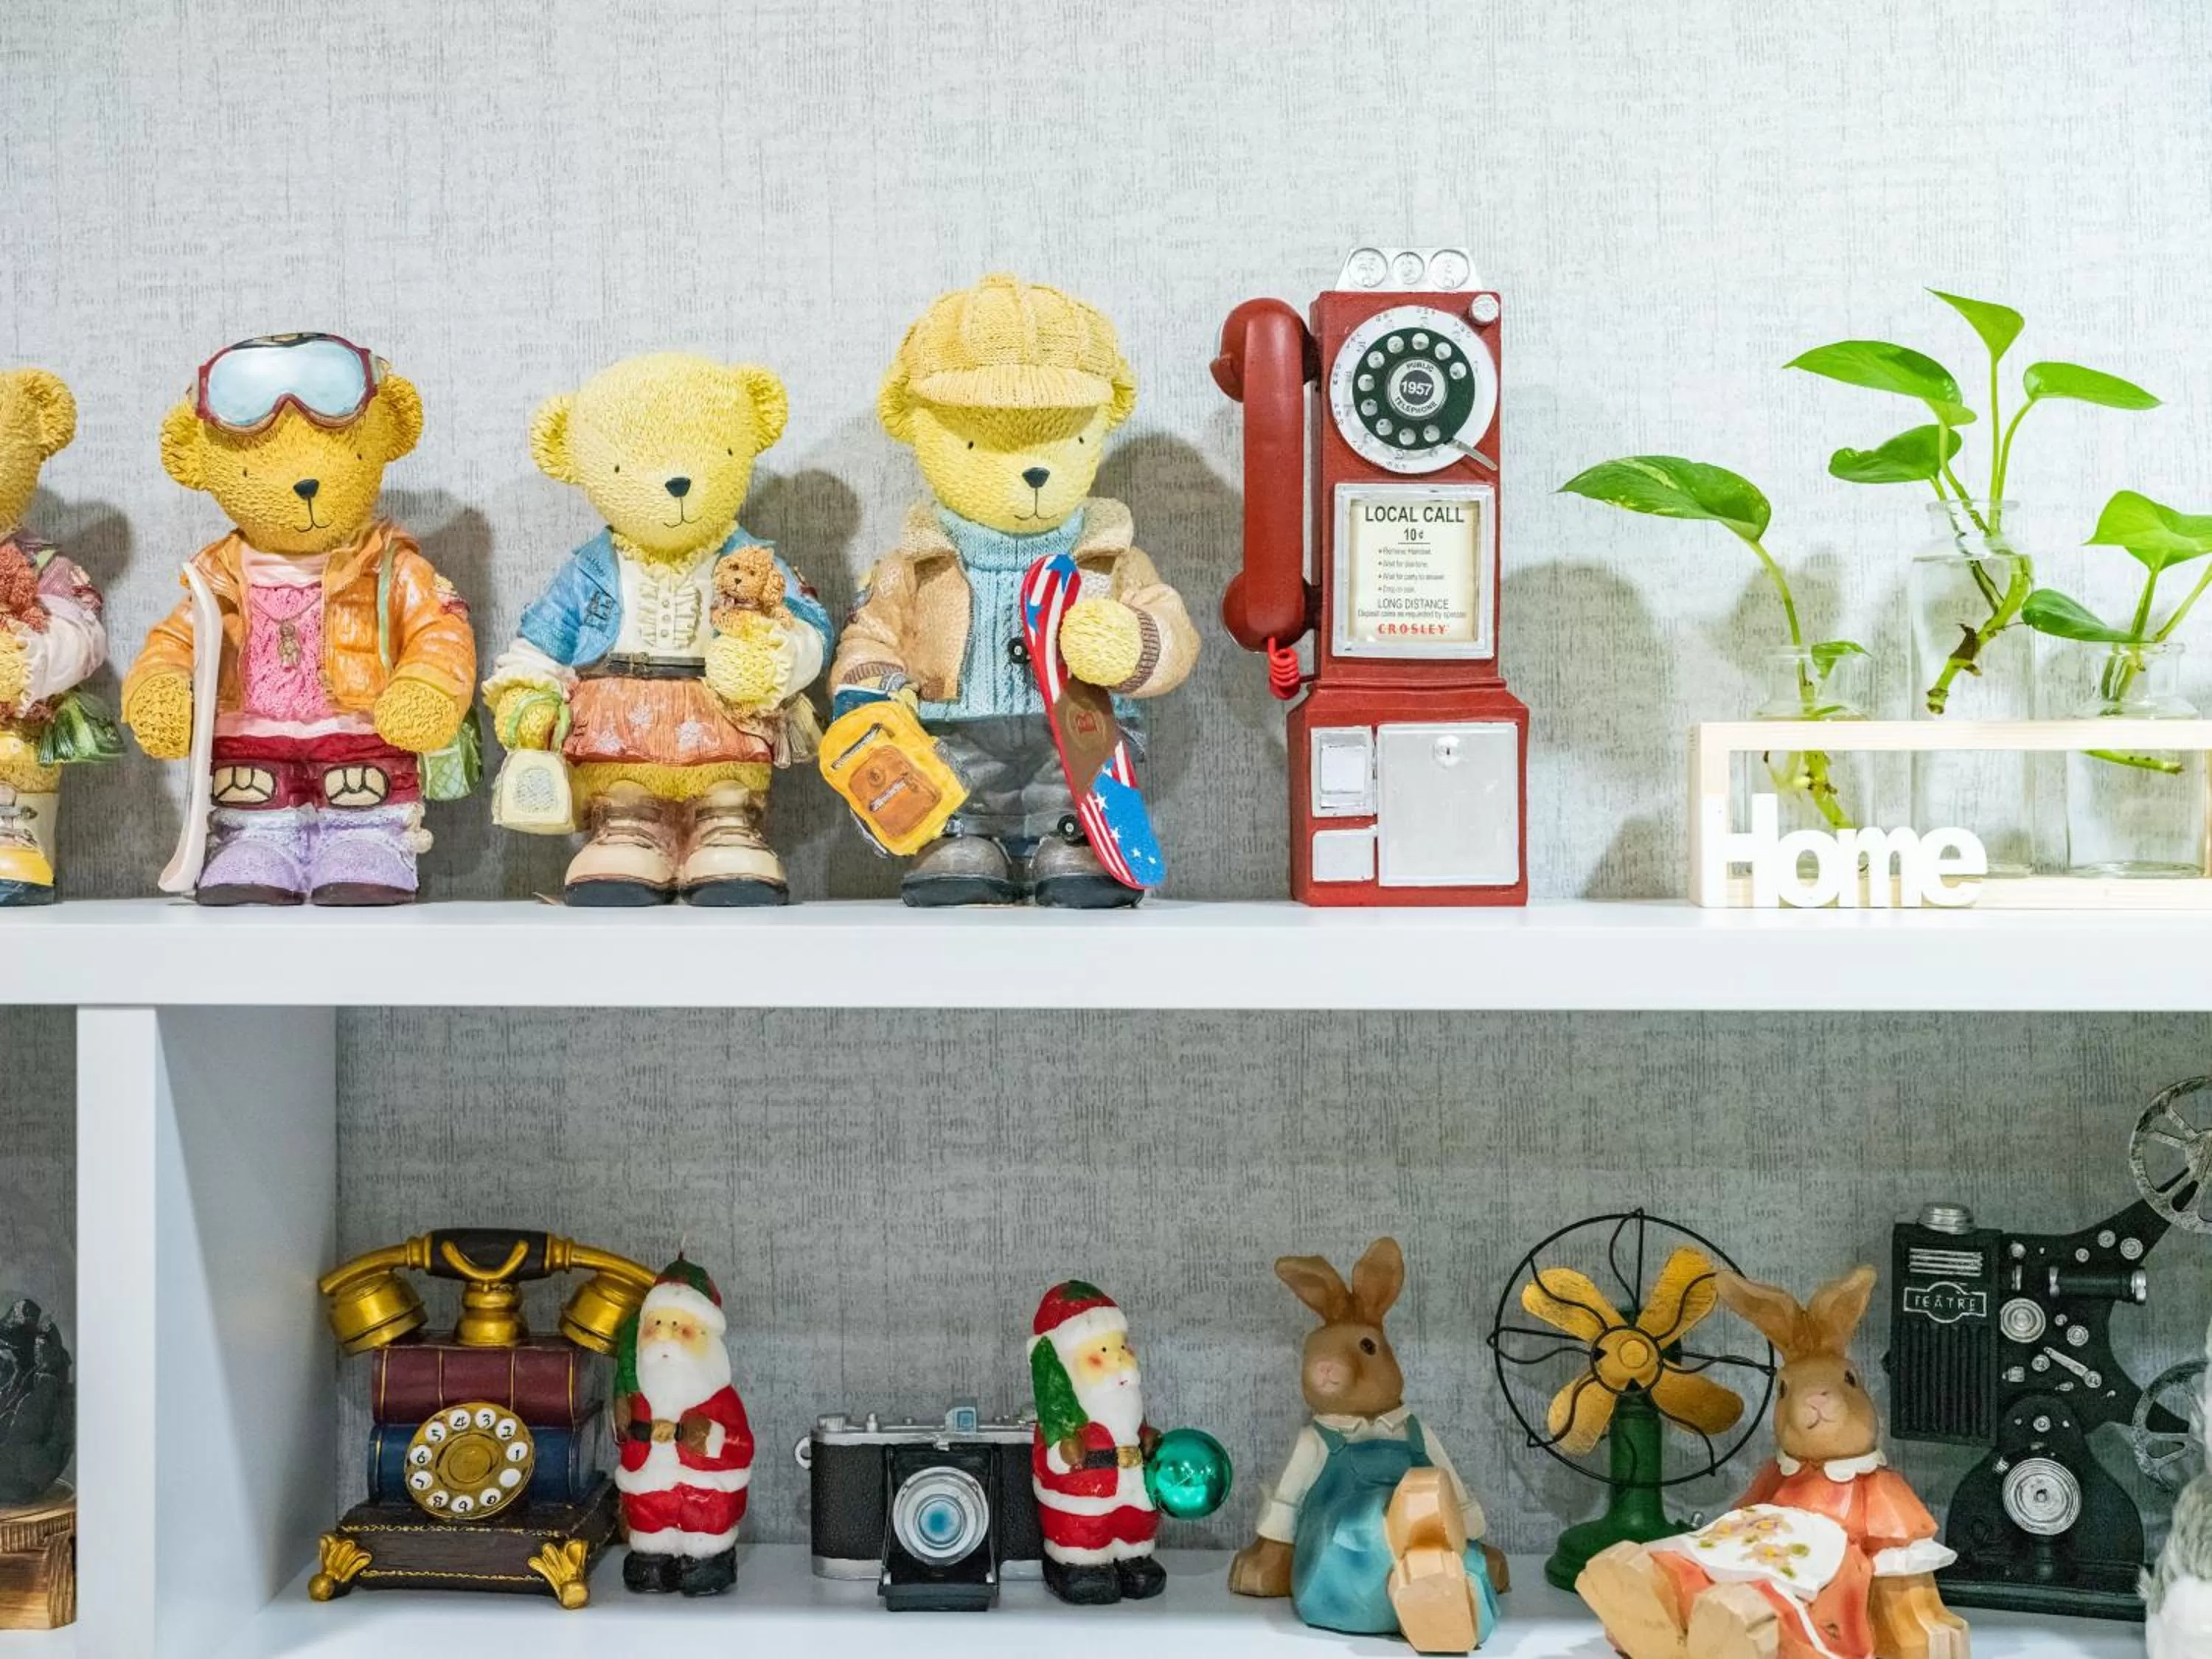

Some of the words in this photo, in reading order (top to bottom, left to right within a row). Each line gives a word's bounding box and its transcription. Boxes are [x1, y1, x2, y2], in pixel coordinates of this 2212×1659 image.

[1406, 361, 1434, 372] PUBLIC
[1402, 380, 1433, 396] 1957
[1365, 506, 1418, 523] LOCAL
[1423, 507, 1464, 523] CALL
[1377, 598, 1402, 609] LONG
[1405, 598, 1449, 610] DISTANCE
[1378, 623, 1446, 635] CROSLEY
[1702, 793, 1988, 908] Home
[453, 1416, 467, 1427] 4
[482, 1413, 490, 1427] 3
[501, 1425, 512, 1438] 2
[417, 1450, 425, 1464] 6
[515, 1449, 520, 1461] 1
[415, 1478, 425, 1488] 7
[458, 1500, 468, 1512] 9
[486, 1495, 497, 1505] 0
